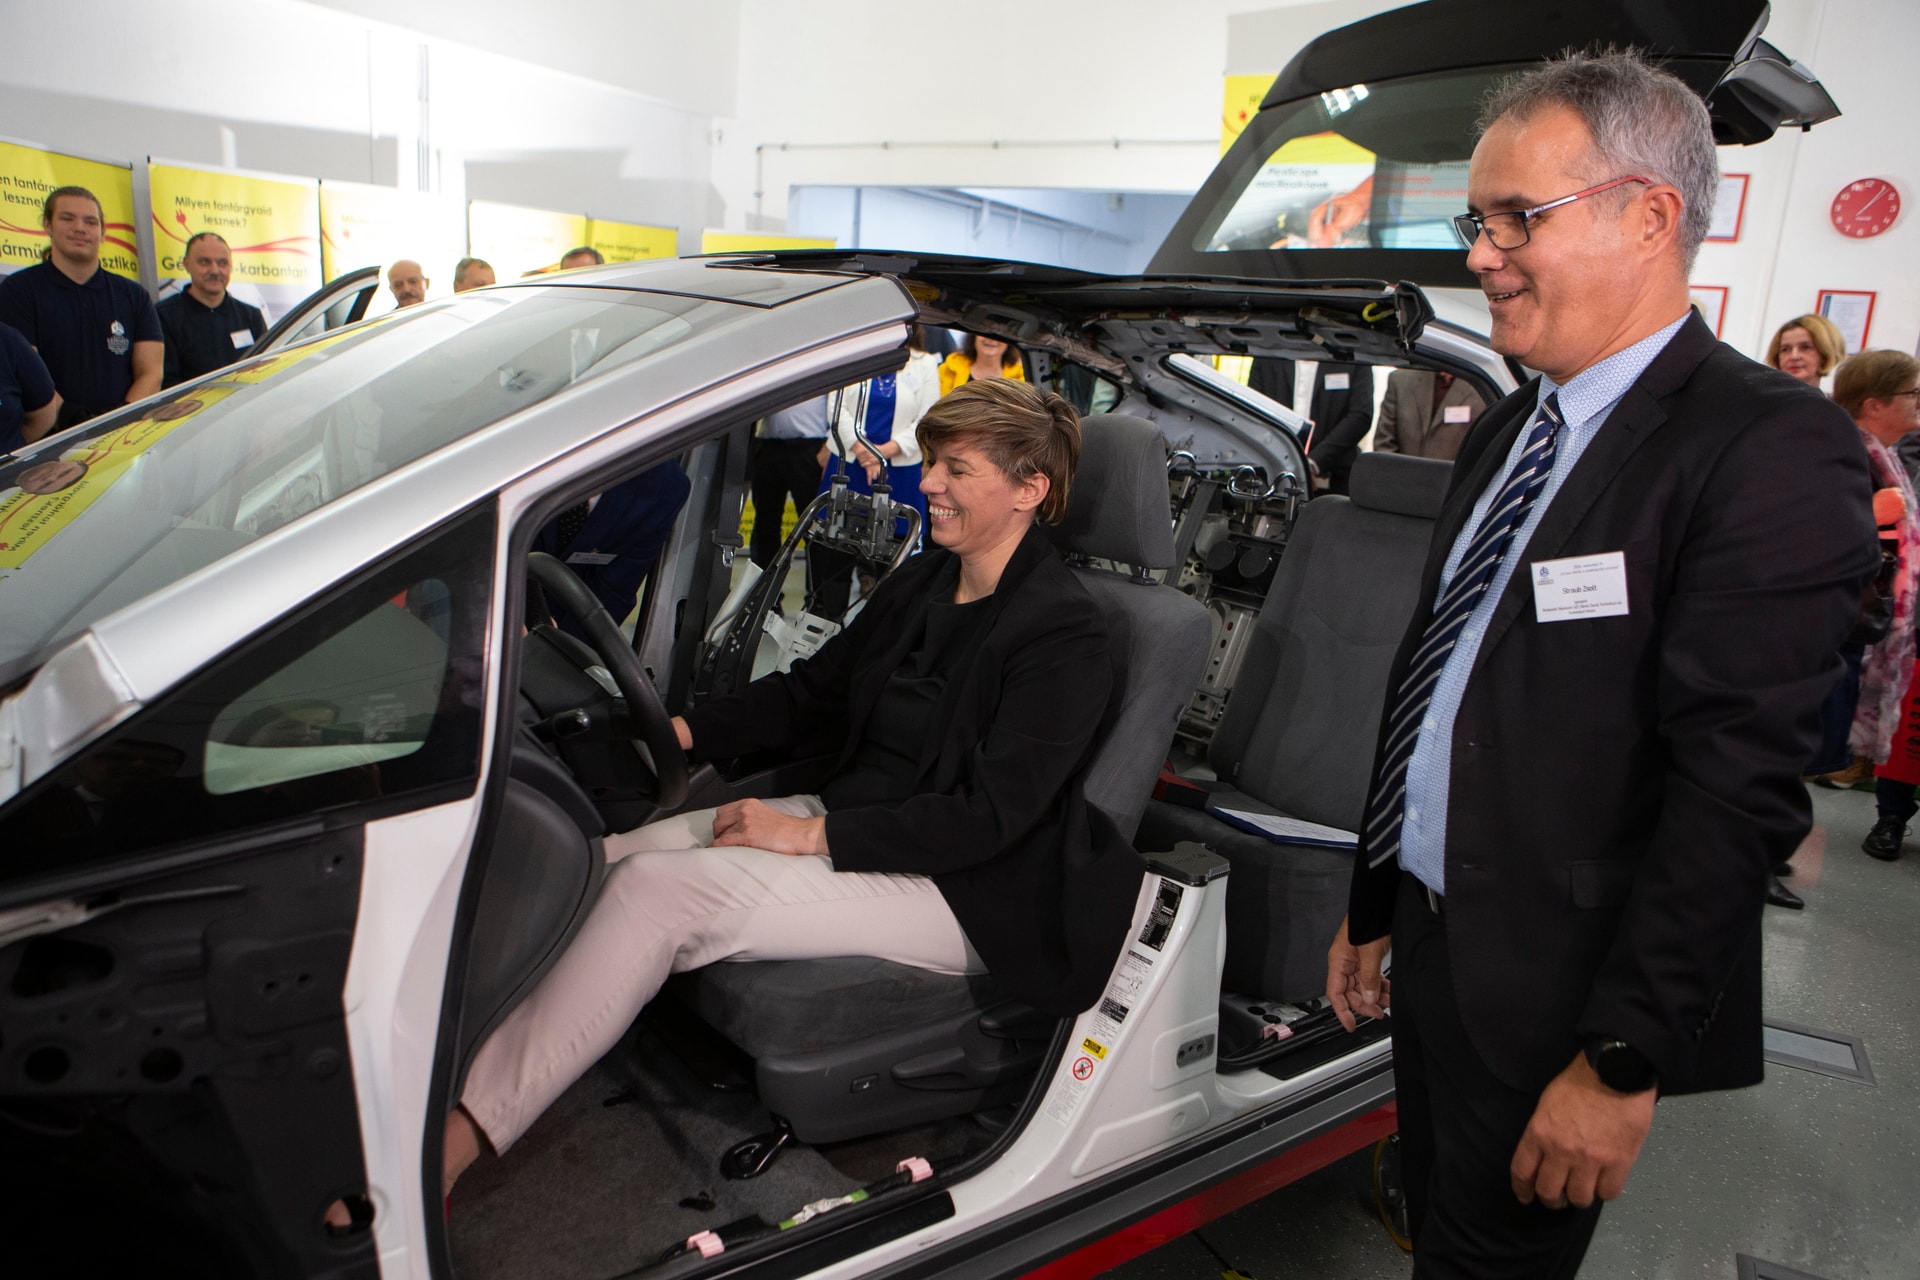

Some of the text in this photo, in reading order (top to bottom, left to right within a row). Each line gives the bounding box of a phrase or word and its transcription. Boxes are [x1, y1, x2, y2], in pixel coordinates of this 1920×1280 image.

[175, 196, 272, 216] Milyen tantárgyaid
[204, 214, 247, 228] lesznek?
[1562, 586, 1582, 595] Straub
